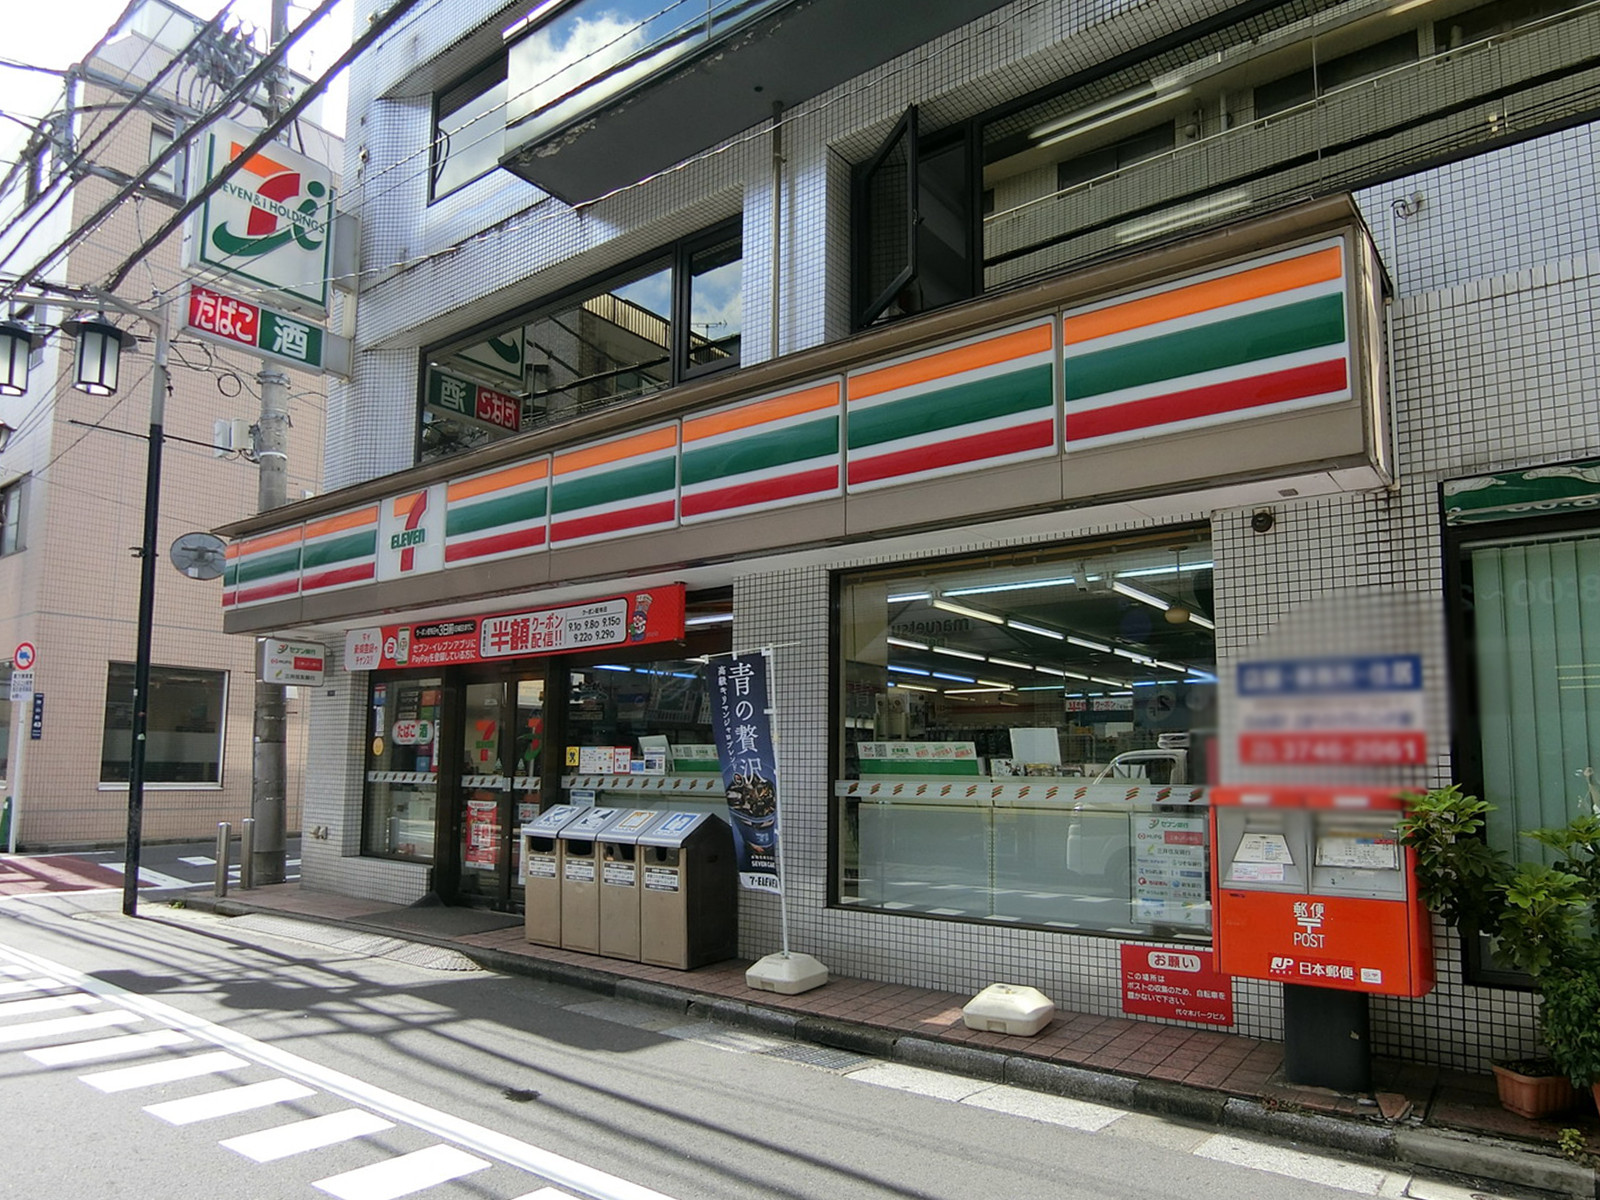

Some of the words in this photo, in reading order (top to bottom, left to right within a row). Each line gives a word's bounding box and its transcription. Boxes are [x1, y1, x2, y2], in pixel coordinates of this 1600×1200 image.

[269, 201, 326, 234] HOLDINGS
[194, 291, 253, 341] たばこ
[272, 316, 309, 360] 酒
[532, 614, 564, 632] クーポン
[490, 618, 530, 652] 半額
[397, 724, 416, 738] たばこ
[728, 662, 768, 784] 青の贅沢
[1293, 902, 1325, 919] 郵便
[1293, 931, 1325, 949] POST
[1154, 954, 1195, 969] お願い
[1127, 971, 1165, 982] この場所は
[1299, 962, 1354, 980] 日本郵便
[1175, 1008, 1226, 1021] 代々木パークビル
